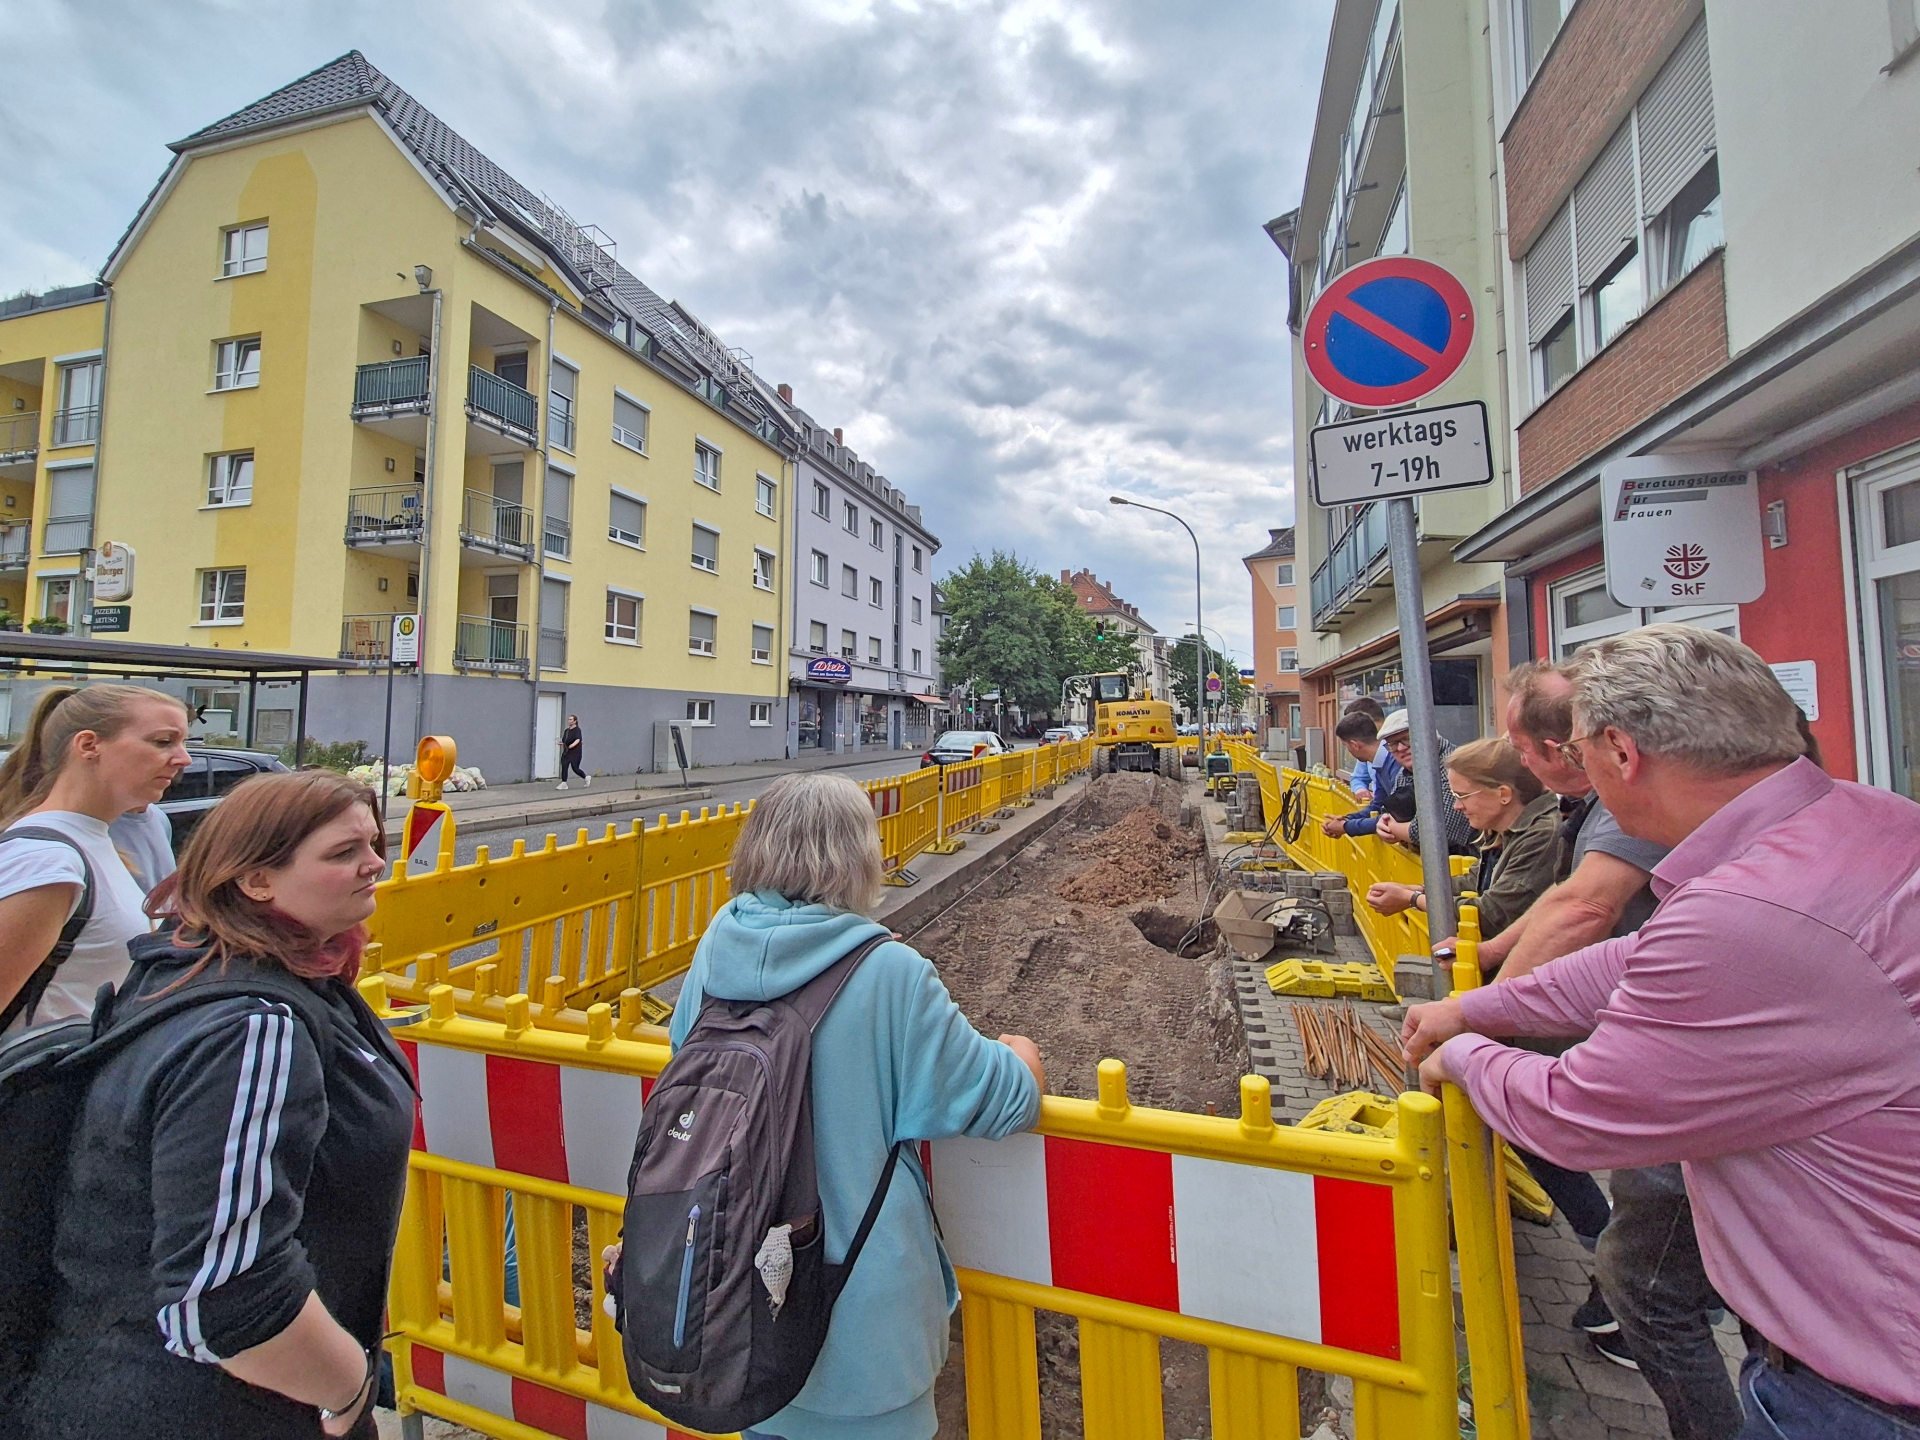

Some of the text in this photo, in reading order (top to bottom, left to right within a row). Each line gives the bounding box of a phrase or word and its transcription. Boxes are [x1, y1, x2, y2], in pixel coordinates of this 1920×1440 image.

[1343, 419, 1457, 453] werktags
[1371, 455, 1441, 487] 7-19h
[1623, 474, 1747, 491] Beratungsladen
[1623, 495, 1648, 505] für
[1617, 508, 1673, 519] Frauen
[97, 564, 124, 577] burger
[1671, 582, 1706, 596] SkF
[94, 608, 121, 616] PIZZERIA
[403, 620, 411, 632] H
[813, 661, 846, 672] Dietz
[1116, 709, 1150, 717] KOMATSU
